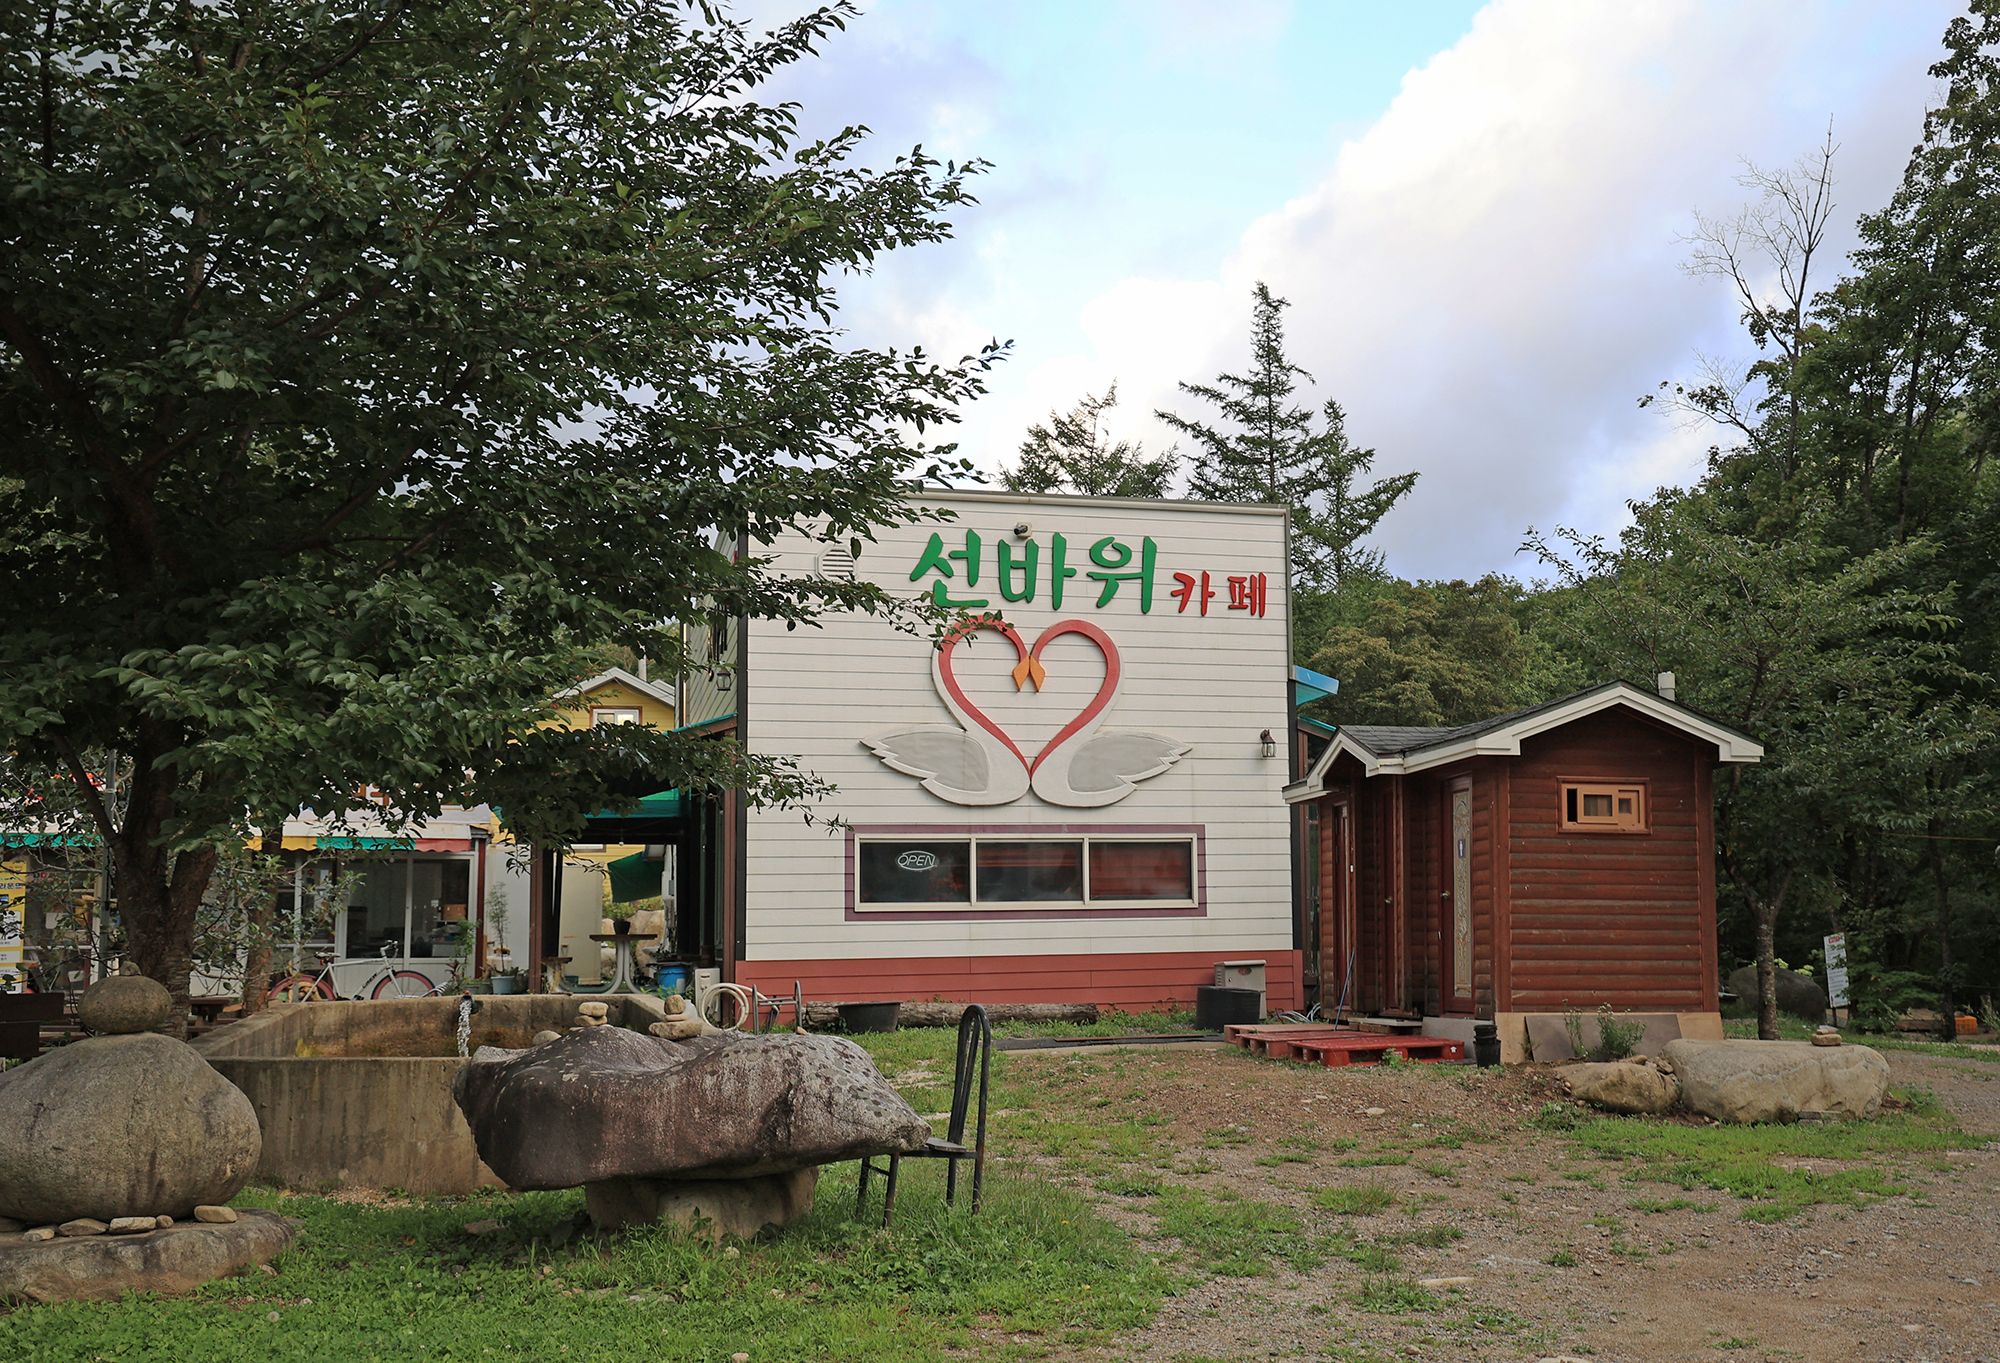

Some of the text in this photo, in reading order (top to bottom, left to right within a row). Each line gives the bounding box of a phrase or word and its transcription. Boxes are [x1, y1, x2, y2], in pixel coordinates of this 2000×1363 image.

[909, 528, 1268, 619] 선바위 카페
[897, 853, 936, 867] OPEN
